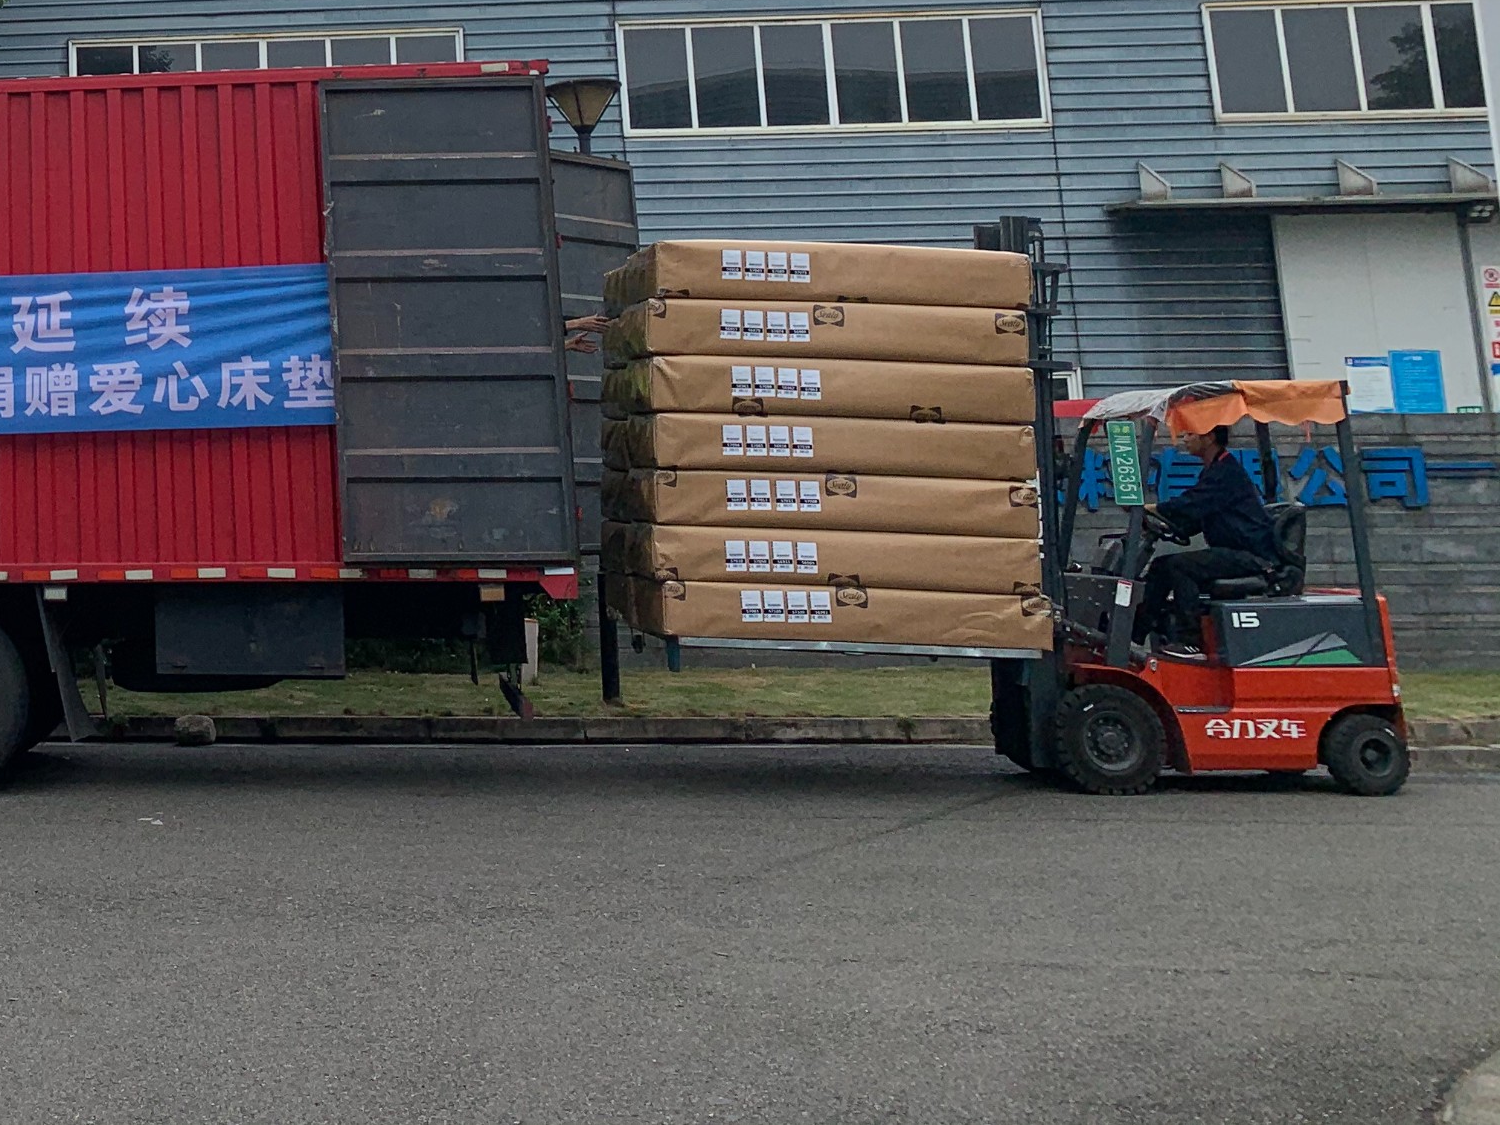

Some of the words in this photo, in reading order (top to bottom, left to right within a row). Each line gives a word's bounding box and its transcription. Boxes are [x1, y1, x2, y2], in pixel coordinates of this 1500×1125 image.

[1231, 612, 1260, 628] 15
[1204, 718, 1307, 739] 合力叉车
